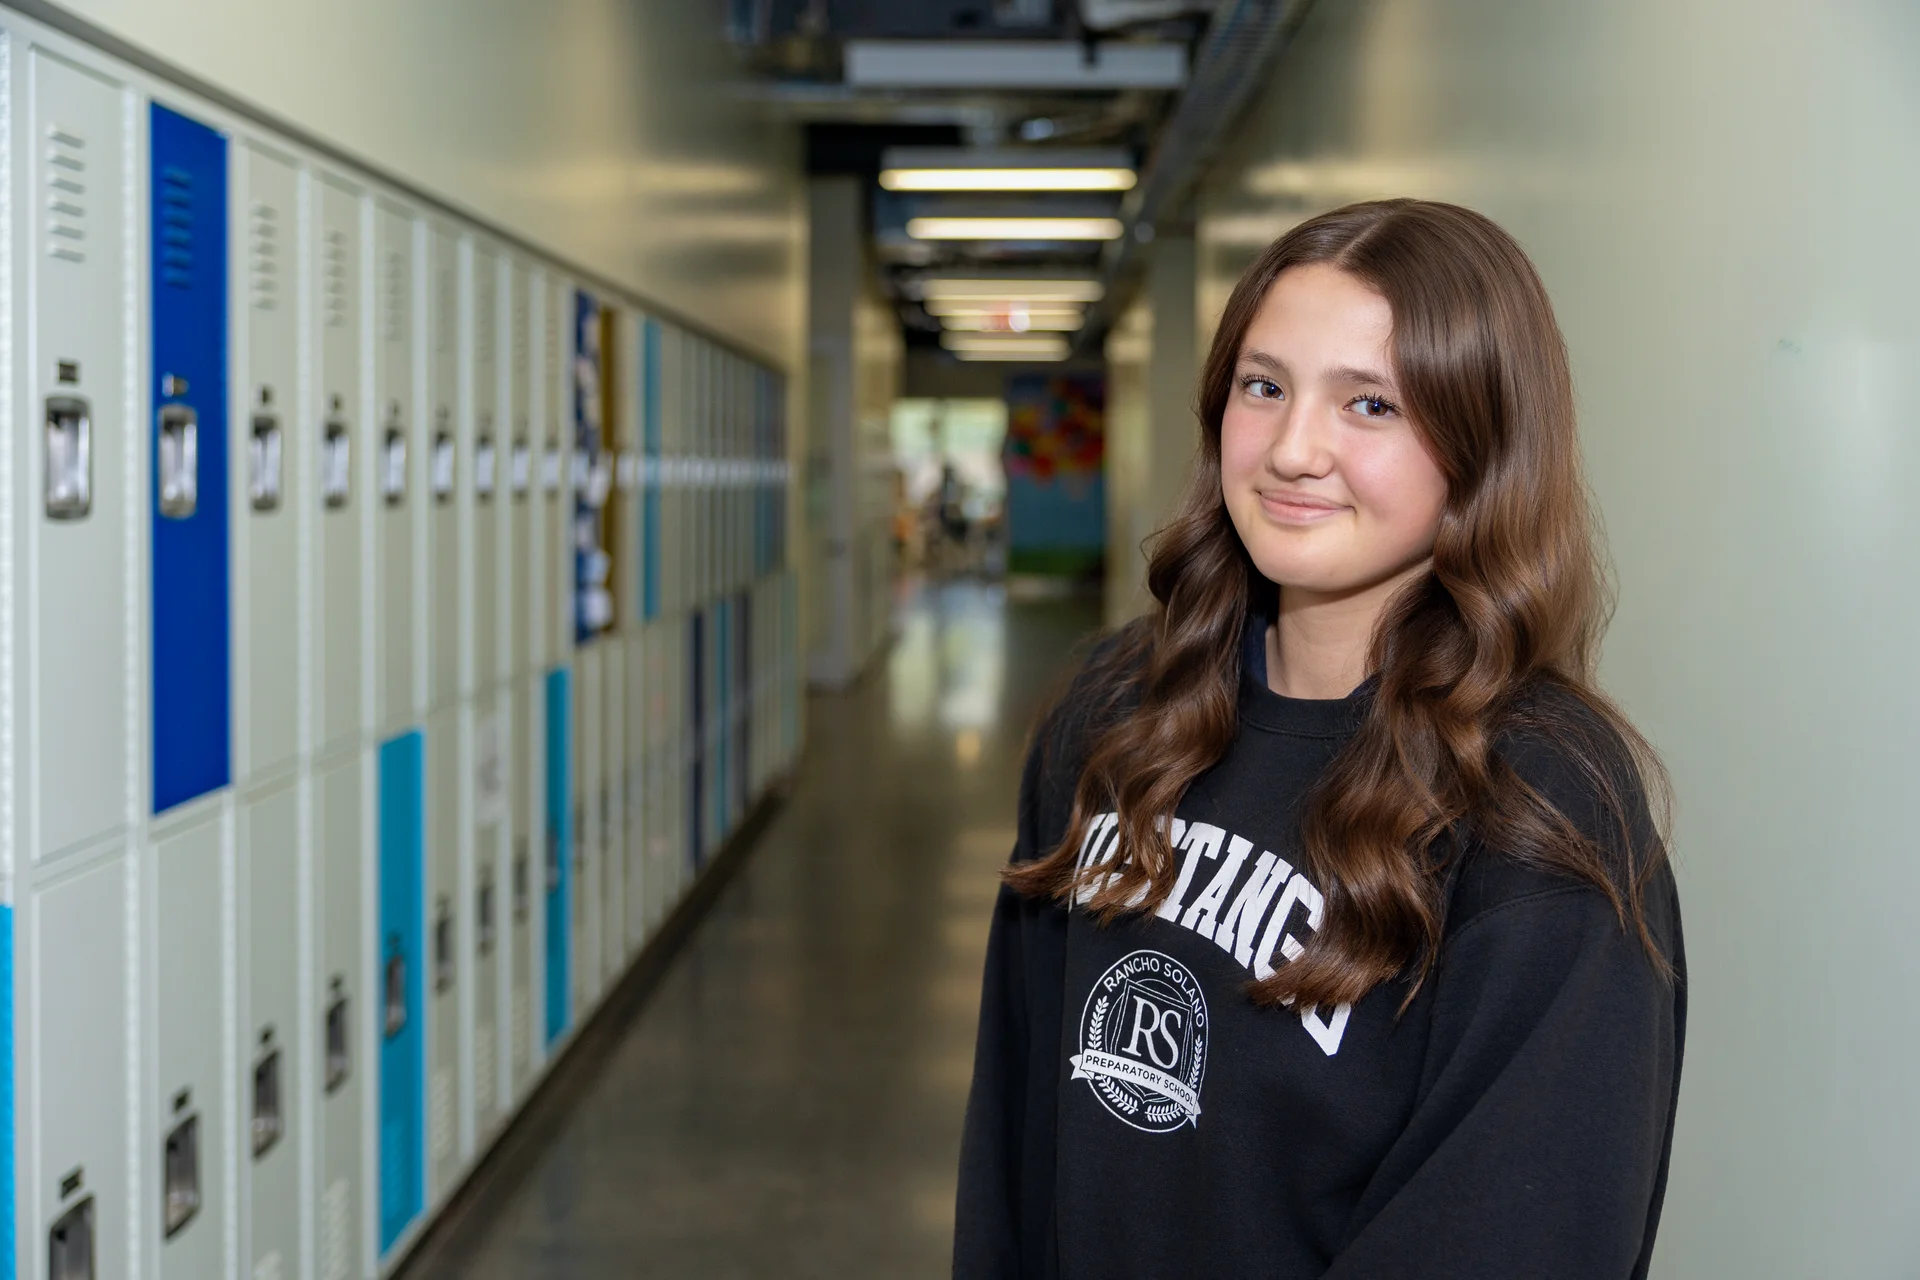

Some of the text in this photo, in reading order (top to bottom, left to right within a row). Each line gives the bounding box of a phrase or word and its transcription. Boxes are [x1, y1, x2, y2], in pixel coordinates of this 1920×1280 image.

[1103, 957, 1204, 1028] RANCHO SOLANO
[1121, 995, 1182, 1070] RS
[1085, 1054, 1194, 1106] PREPARATORY SCHOOL
